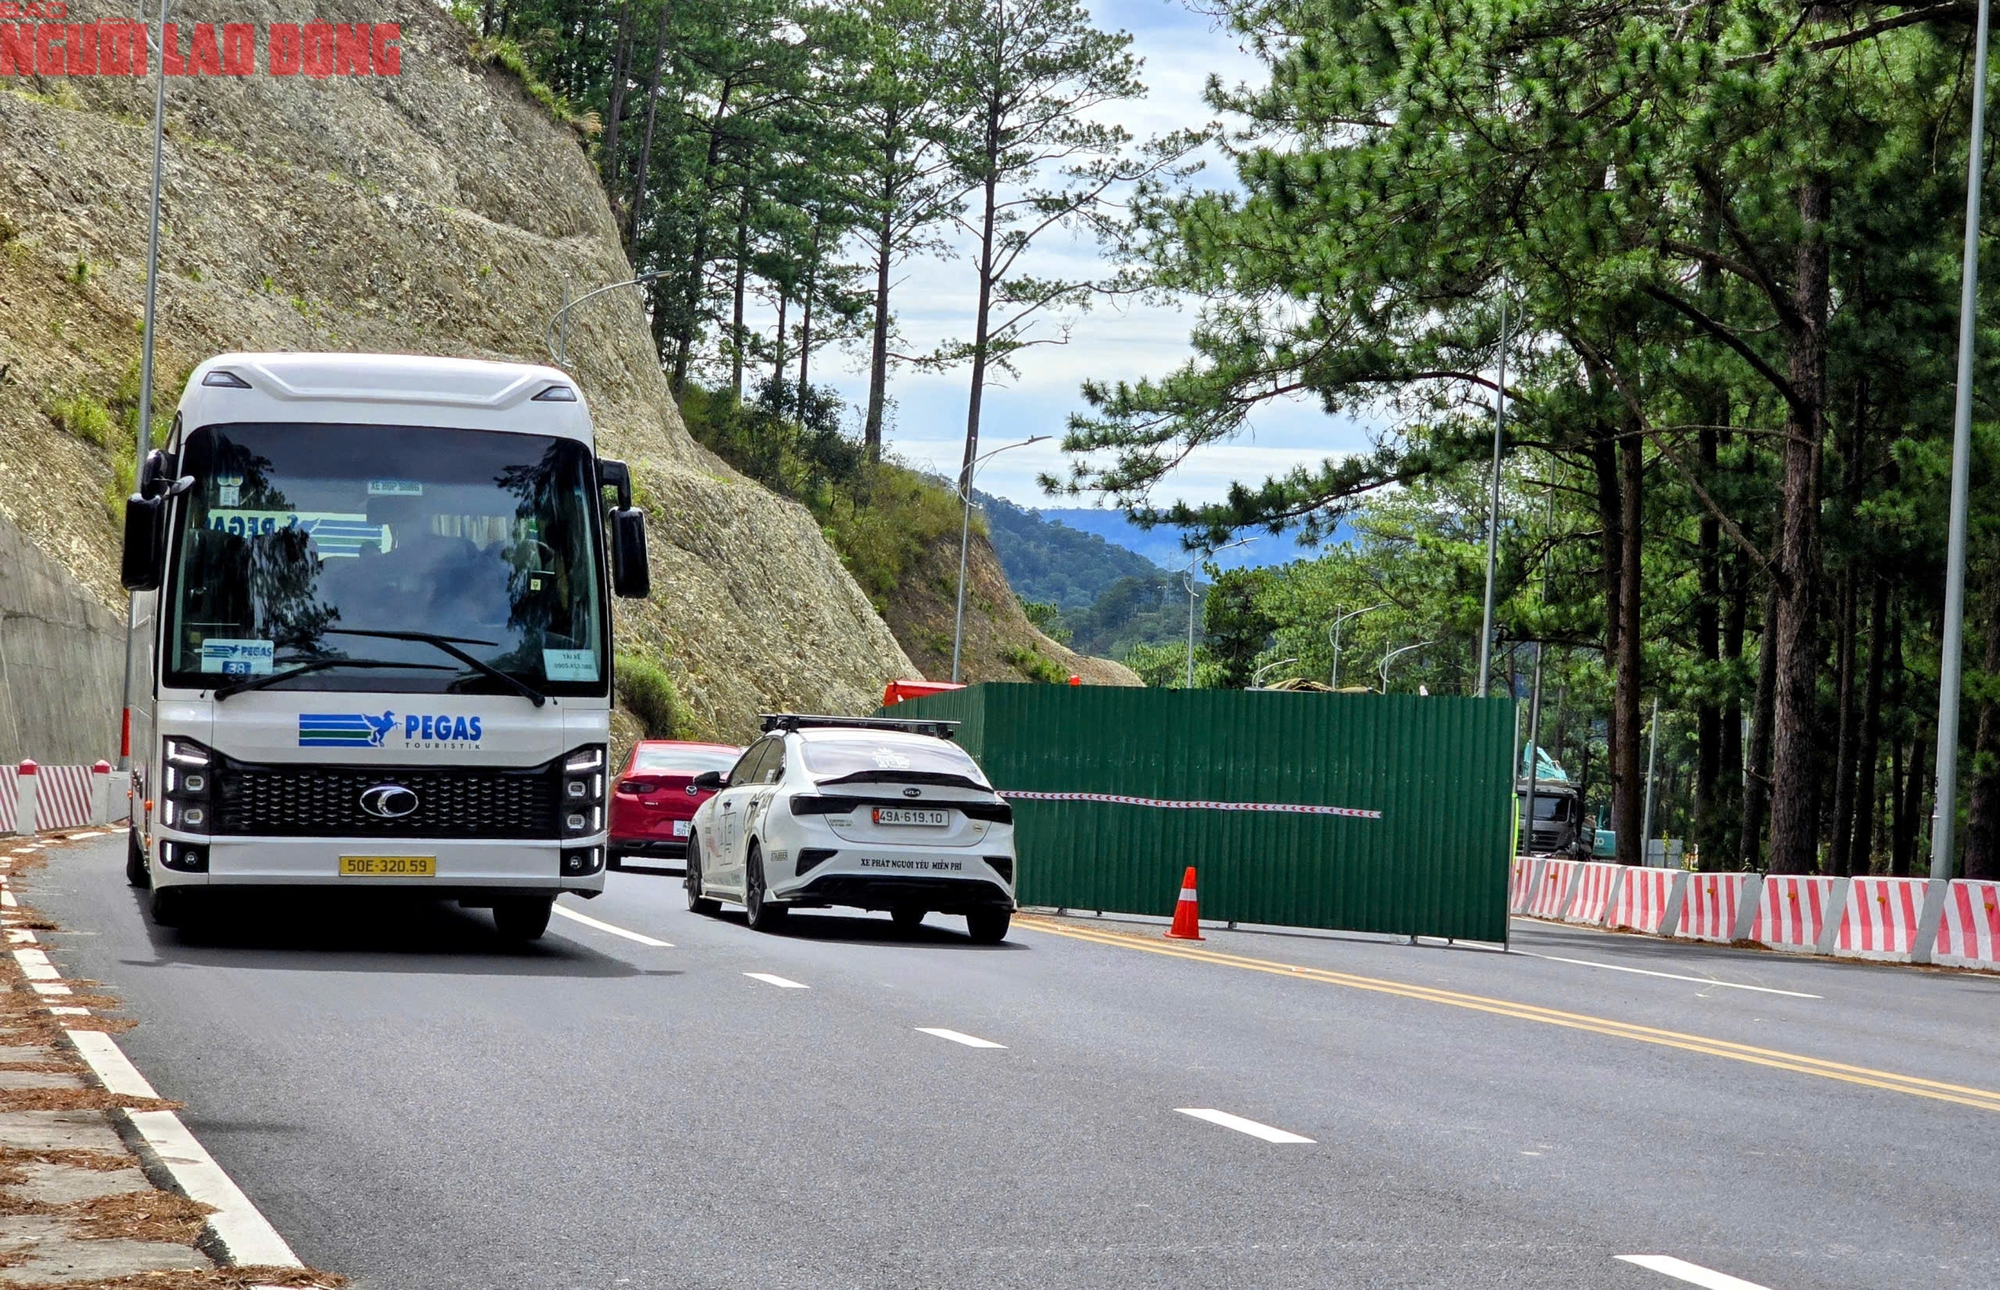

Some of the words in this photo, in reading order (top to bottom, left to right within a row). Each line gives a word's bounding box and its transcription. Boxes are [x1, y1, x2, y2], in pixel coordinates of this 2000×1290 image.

[241, 645, 272, 657] PEGAS
[228, 663, 246, 675] 38
[405, 714, 482, 741] PEGAS
[405, 742, 481, 750] TOURISTIK
[347, 859, 427, 873] 50E-320.59
[861, 859, 870, 867] XE
